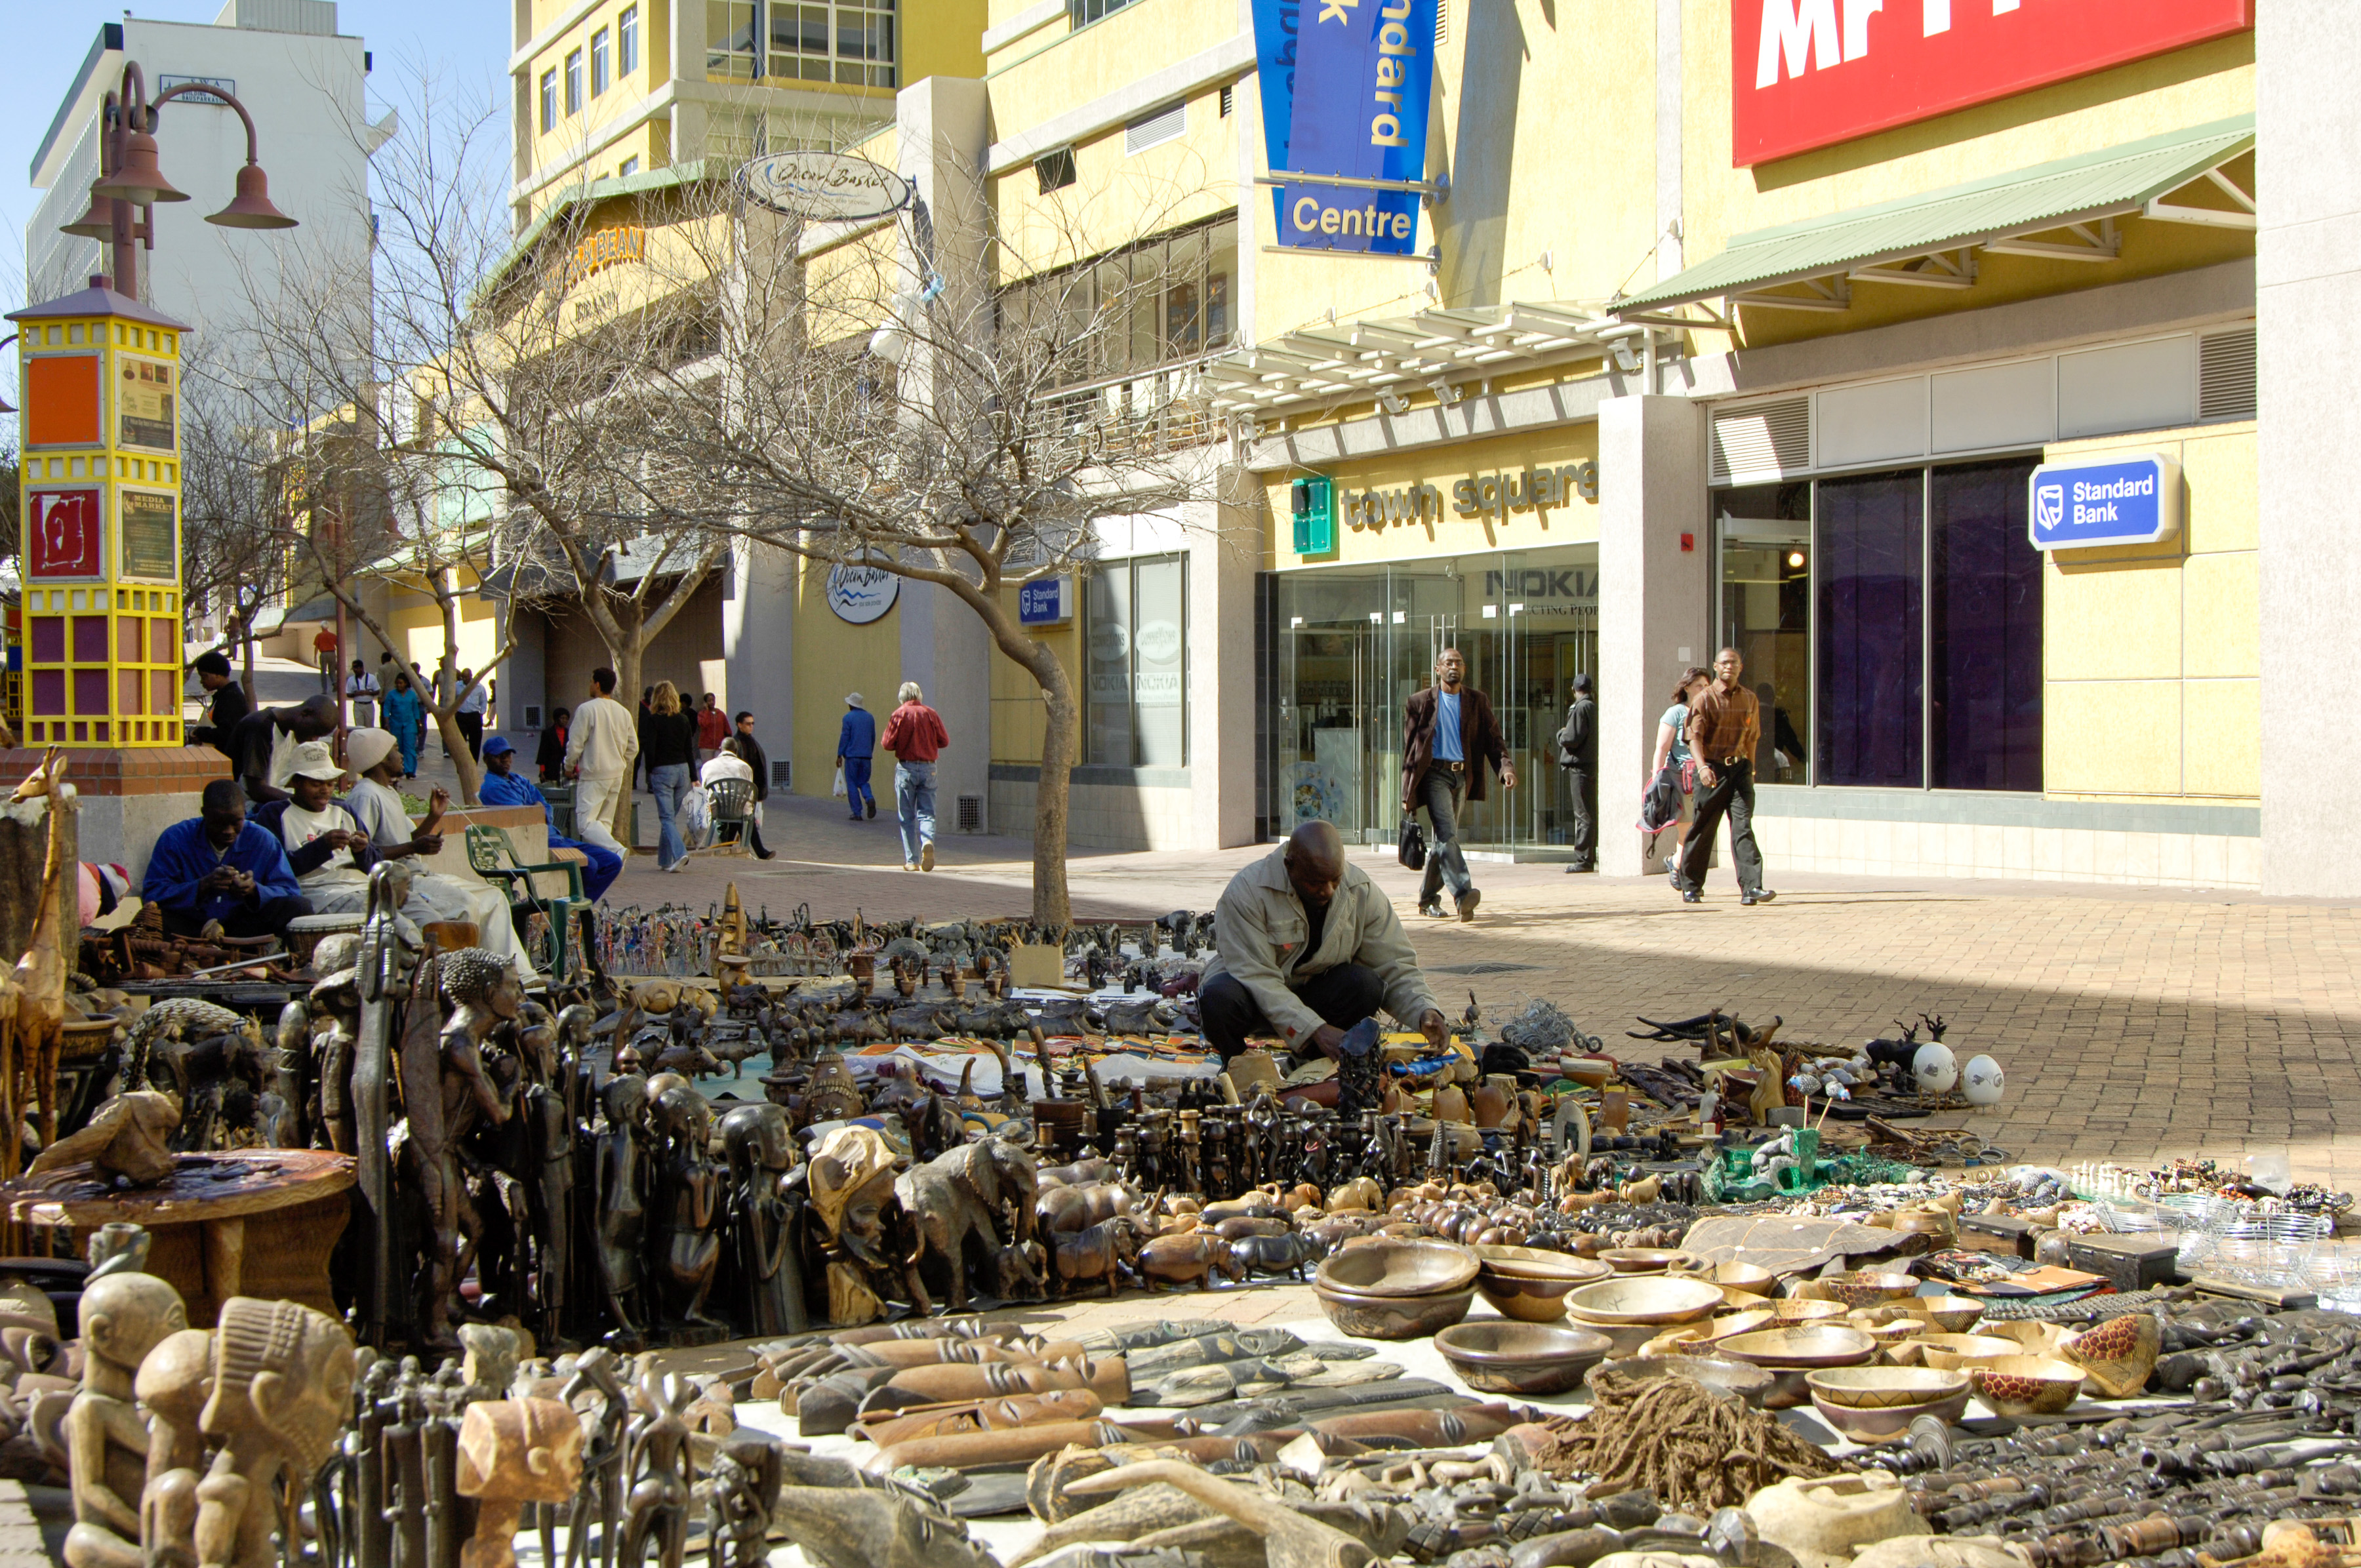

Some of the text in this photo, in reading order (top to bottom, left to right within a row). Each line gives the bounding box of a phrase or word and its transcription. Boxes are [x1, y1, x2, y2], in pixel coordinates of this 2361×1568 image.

[830, 169, 890, 188] Basket
[1293, 197, 1411, 239] Centre
[596, 226, 639, 264] BEAN
[1341, 460, 1598, 526] town square
[2073, 474, 2153, 502] Standard
[134, 495, 164, 504] MEDIA
[134, 502, 173, 510] MARKET
[2073, 502, 2118, 525] Bank
[1033, 588, 1058, 601] Standard
[1034, 601, 1047, 613] Bank
[1091, 675, 1129, 691] NOKIA
[1137, 674, 1178, 690] NOKIA
